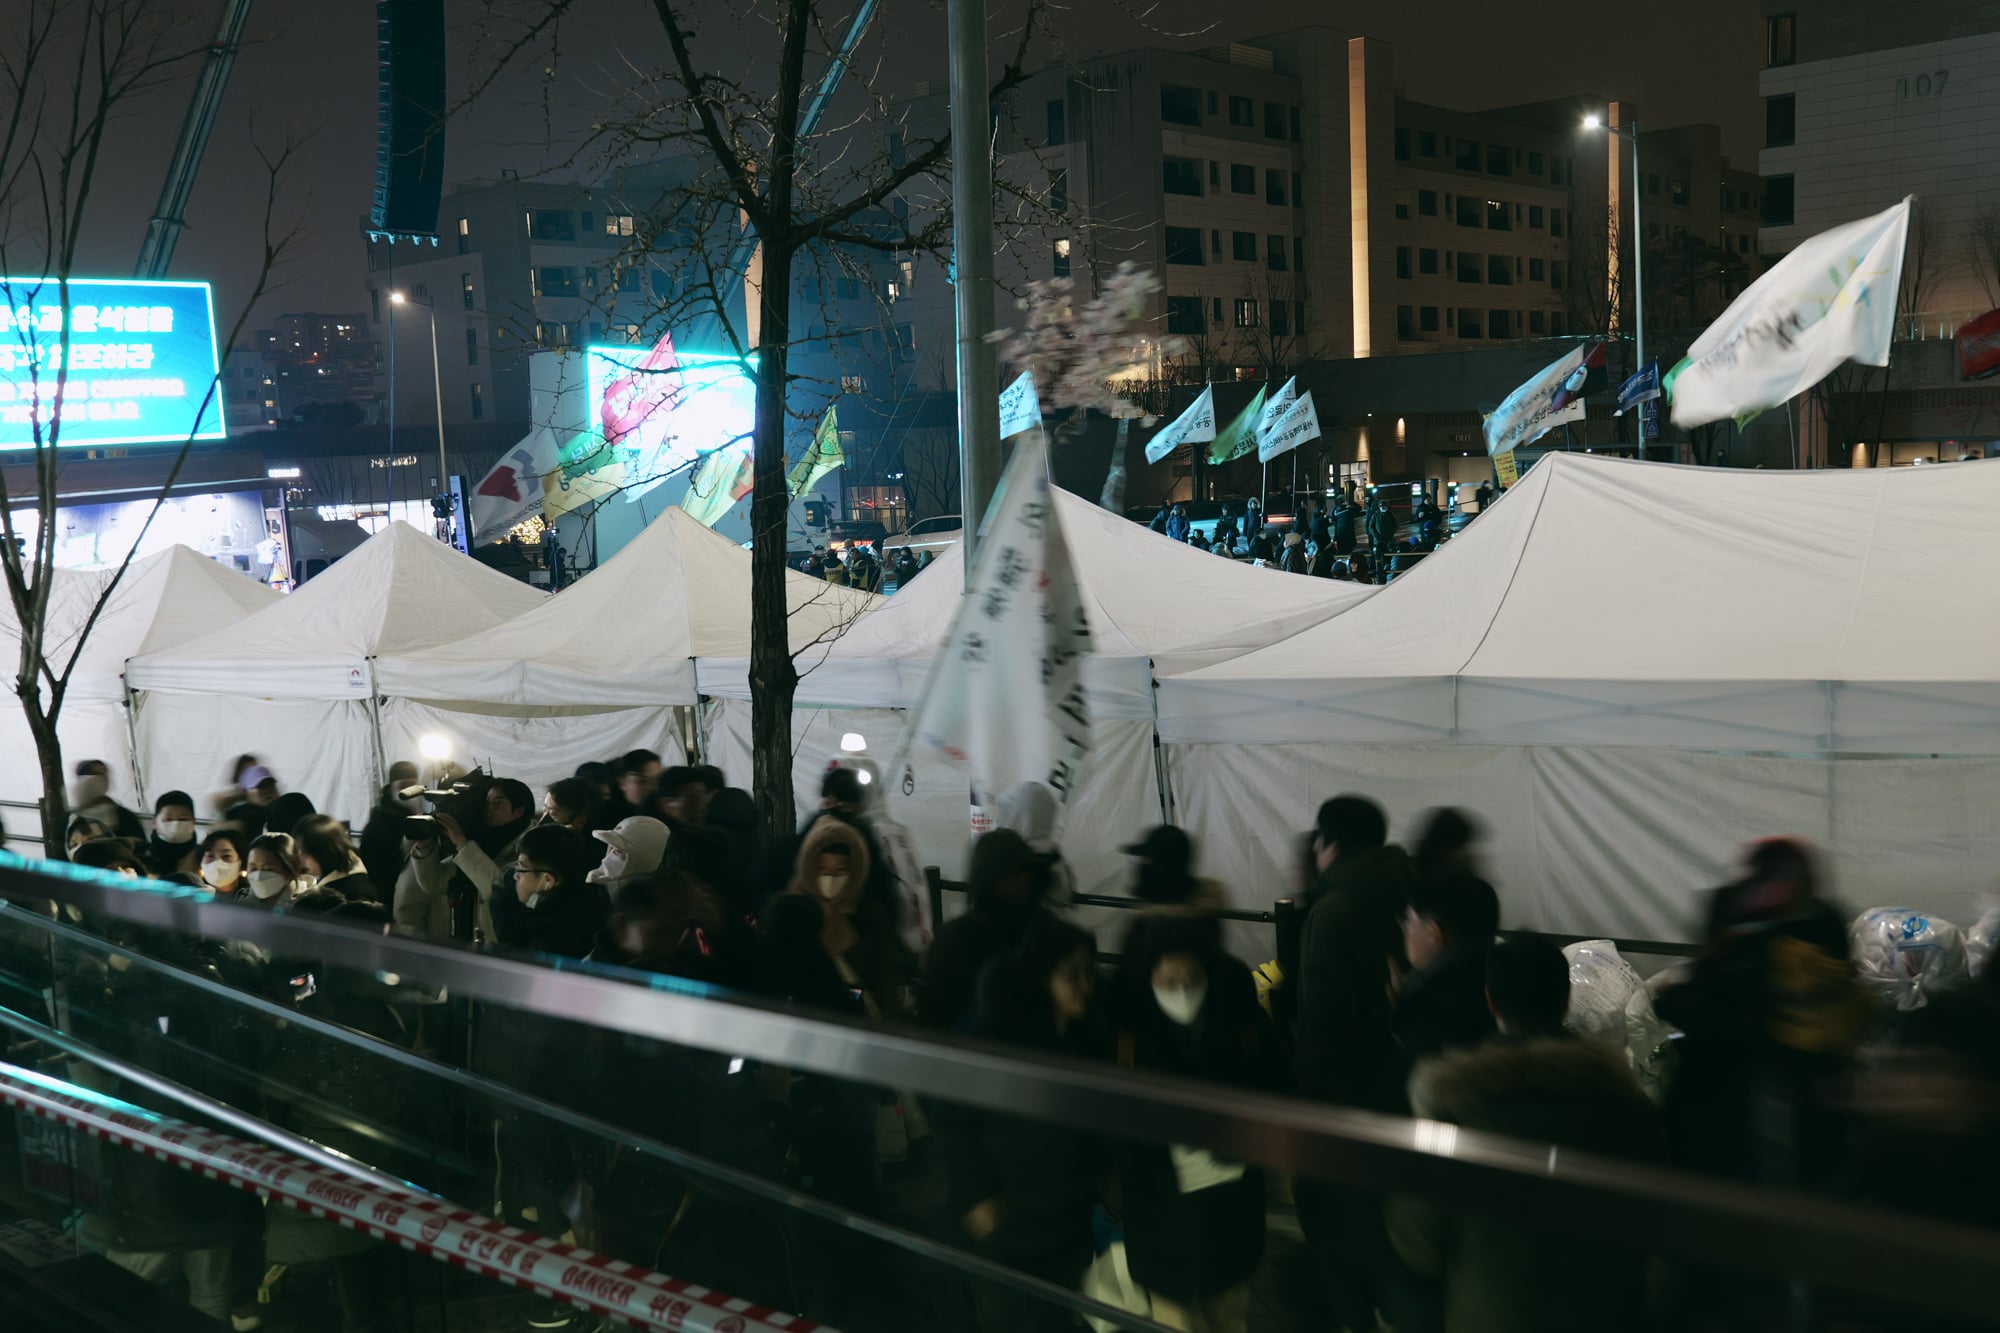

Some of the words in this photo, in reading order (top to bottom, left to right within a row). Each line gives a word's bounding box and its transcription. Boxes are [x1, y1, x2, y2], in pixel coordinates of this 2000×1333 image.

[1896, 70, 1949, 100] 107
[305, 1179, 366, 1211] DANGER
[458, 1230, 542, 1275] 안전제일
[561, 1265, 637, 1306] DANGER
[649, 1294, 693, 1328] 위험
